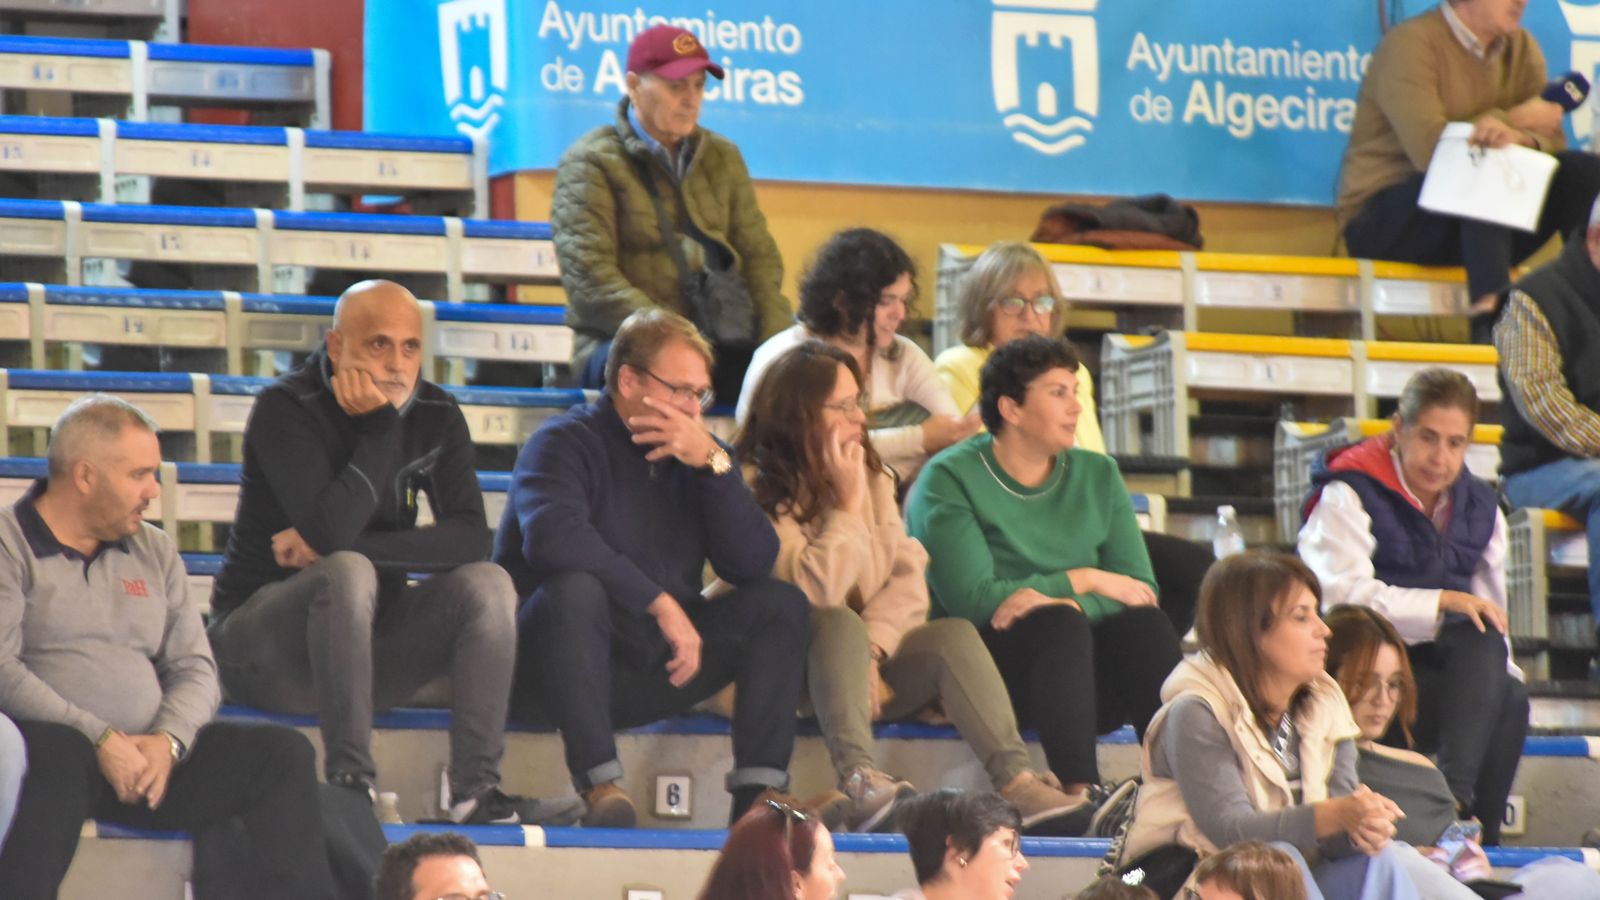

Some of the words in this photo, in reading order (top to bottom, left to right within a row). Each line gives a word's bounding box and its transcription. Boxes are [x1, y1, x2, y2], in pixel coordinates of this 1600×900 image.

[540, 56, 585, 93] de
[1129, 86, 1174, 123] de
[1182, 79, 1357, 139] Algecira
[667, 783, 680, 807] 6
